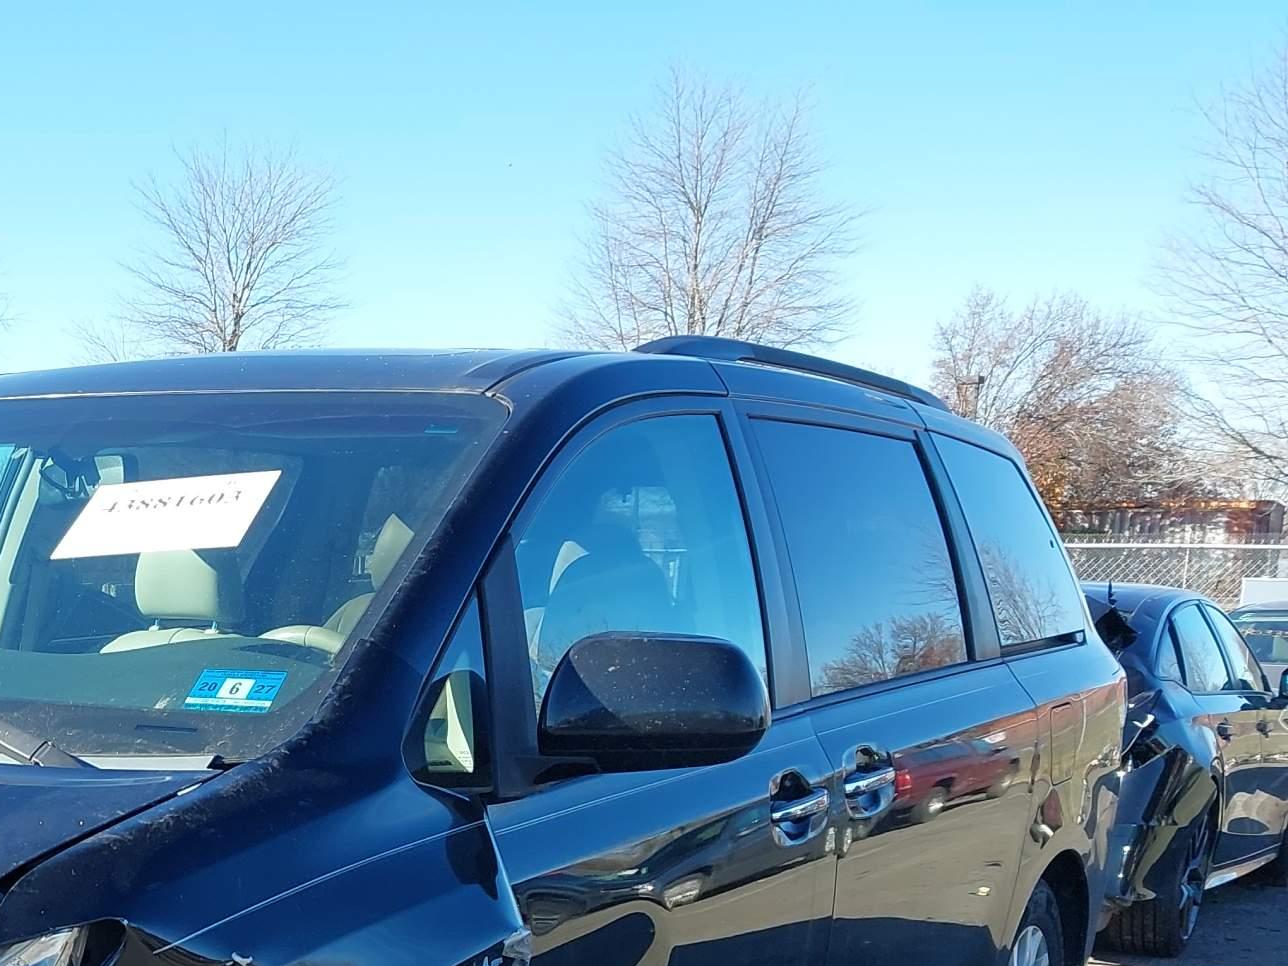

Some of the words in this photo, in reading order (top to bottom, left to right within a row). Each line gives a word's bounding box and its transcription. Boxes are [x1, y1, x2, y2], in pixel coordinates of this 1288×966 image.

[198, 681, 218, 692] 20
[228, 681, 242, 695] 6
[253, 684, 277, 694] 27
